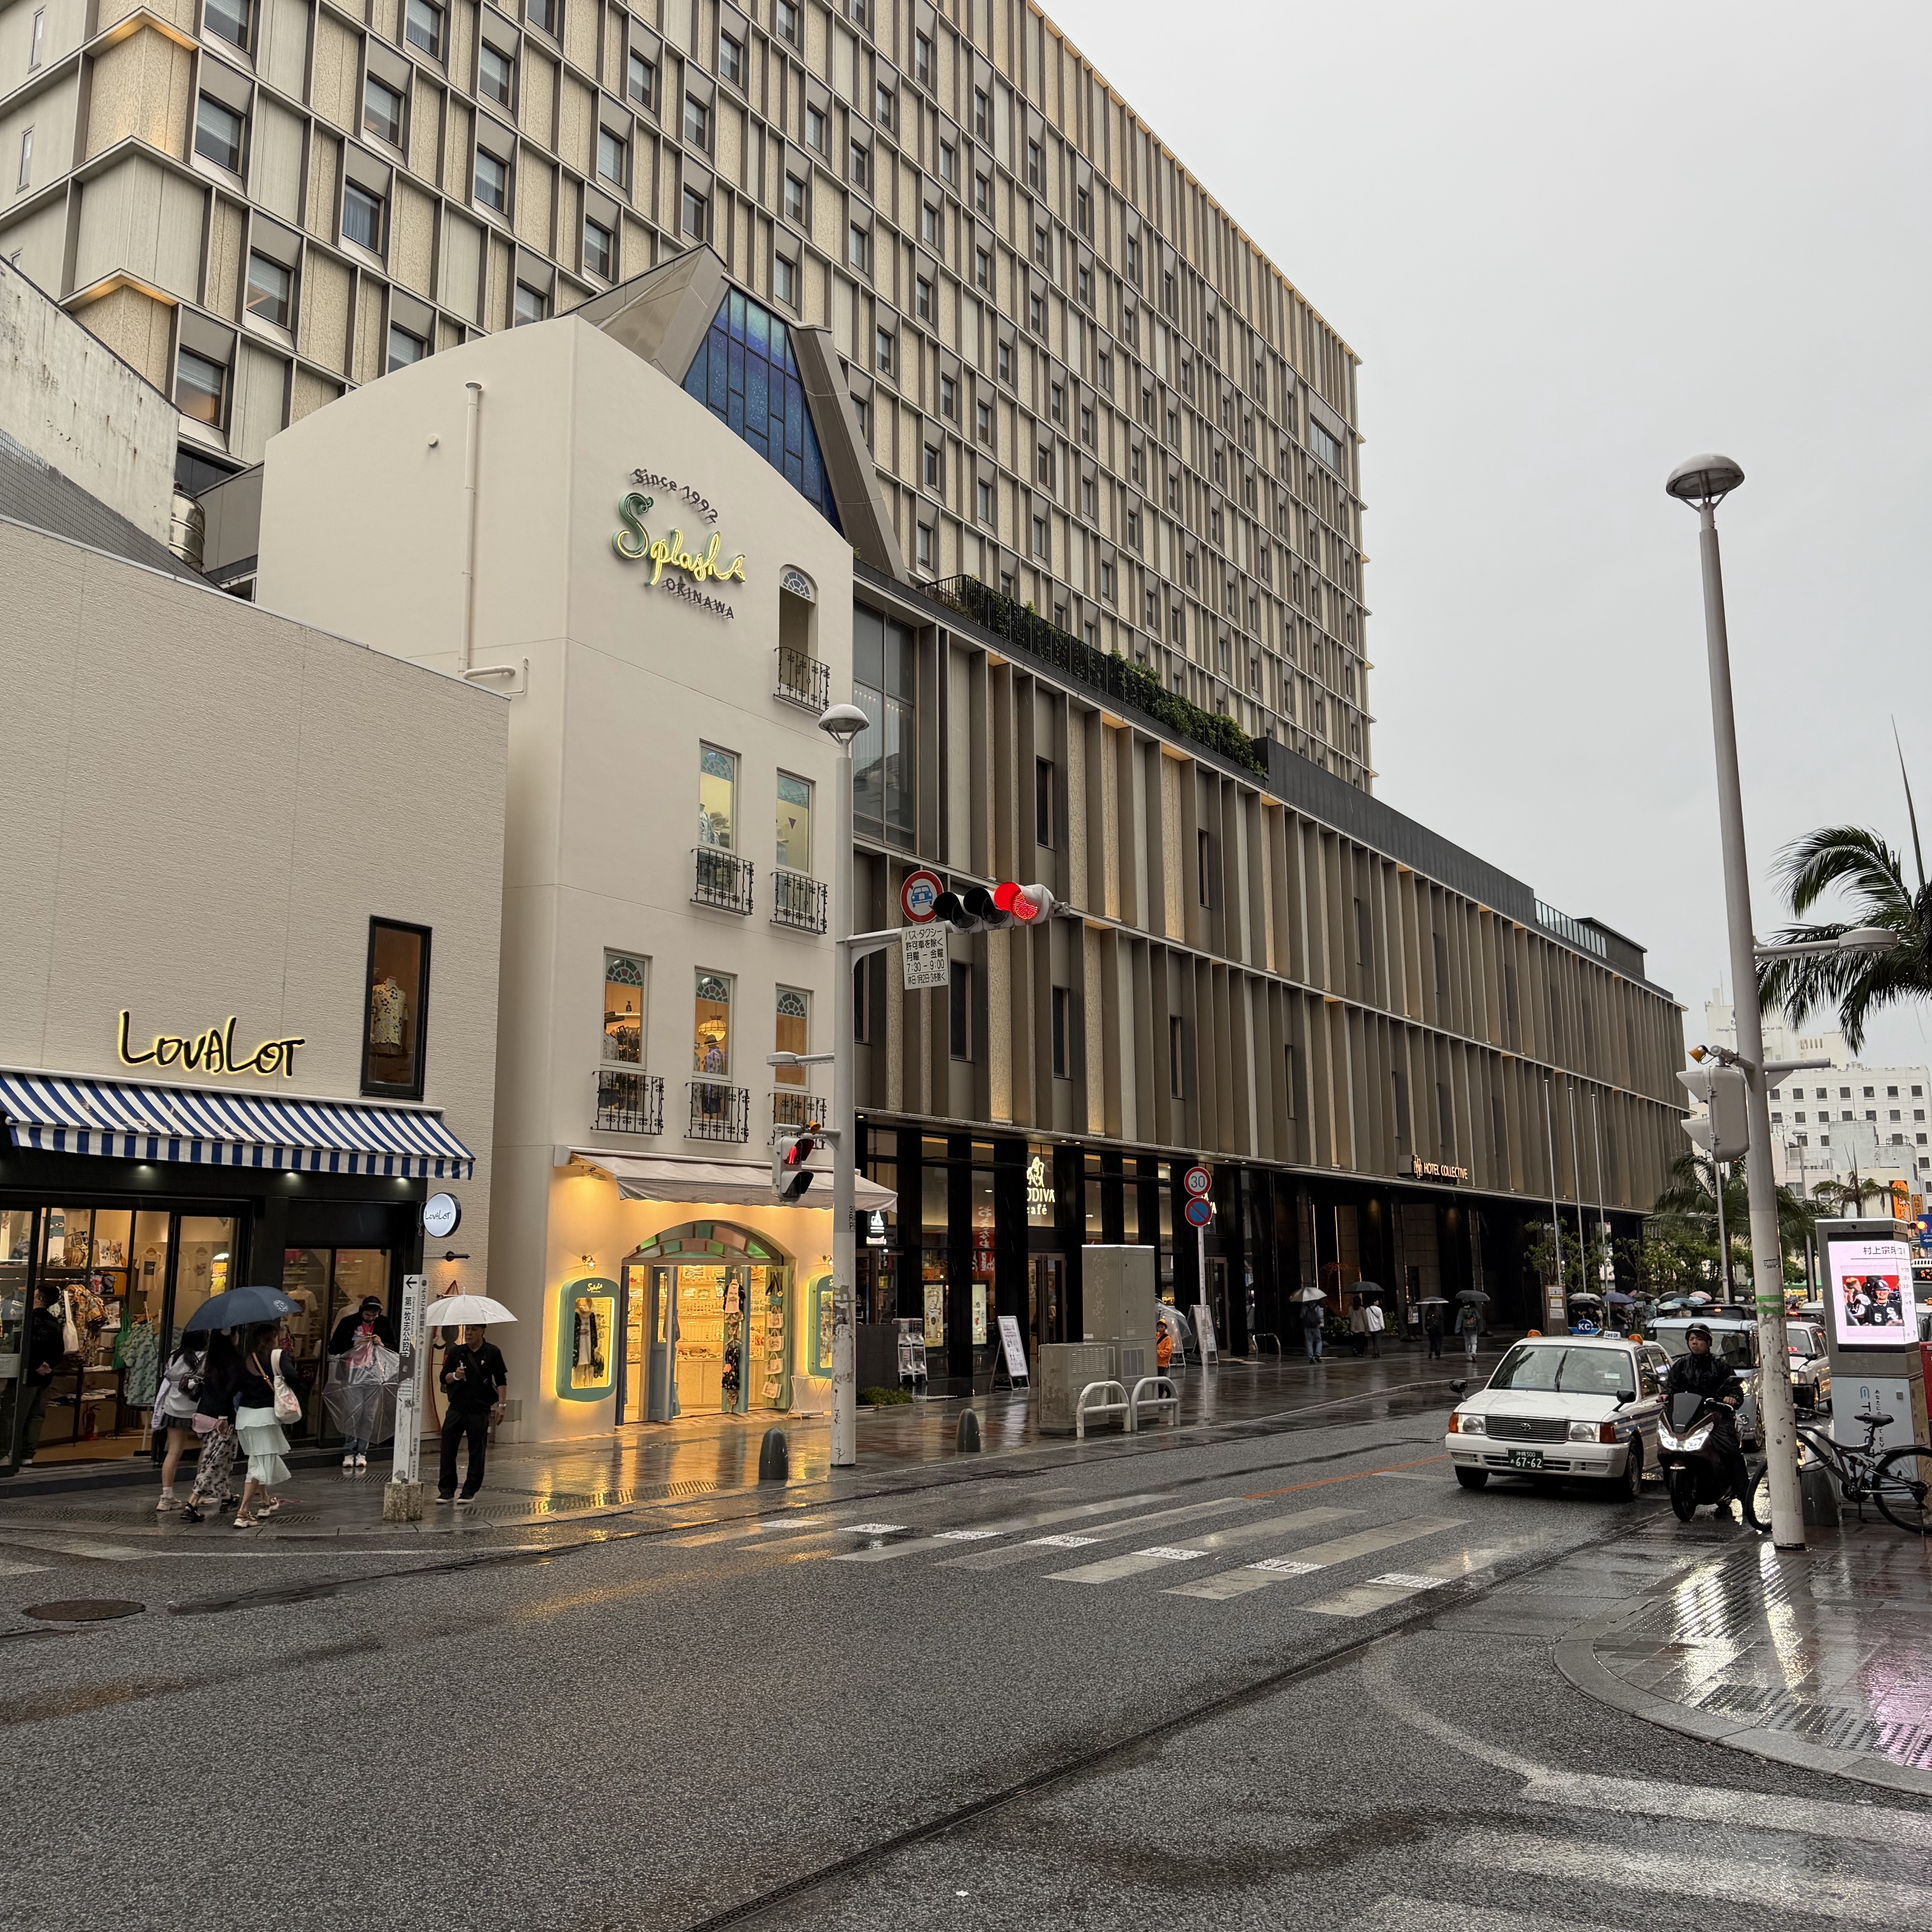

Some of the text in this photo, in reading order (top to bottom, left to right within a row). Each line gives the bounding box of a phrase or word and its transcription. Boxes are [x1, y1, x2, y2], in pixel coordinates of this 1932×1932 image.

[631, 468, 718, 524] Since 1992
[612, 492, 747, 587] Splash
[665, 577, 734, 619] OKINAWA
[906, 937, 943, 951] 許可車を除く
[1423, 1162, 1468, 1179] HOTEL COLLECTIVE
[1191, 1175, 1205, 1188] 30
[1027, 1187, 1055, 1202] ODIVA
[1874, 1313, 1881, 1322] 5
[1516, 1457, 1542, 1468] 67-62
